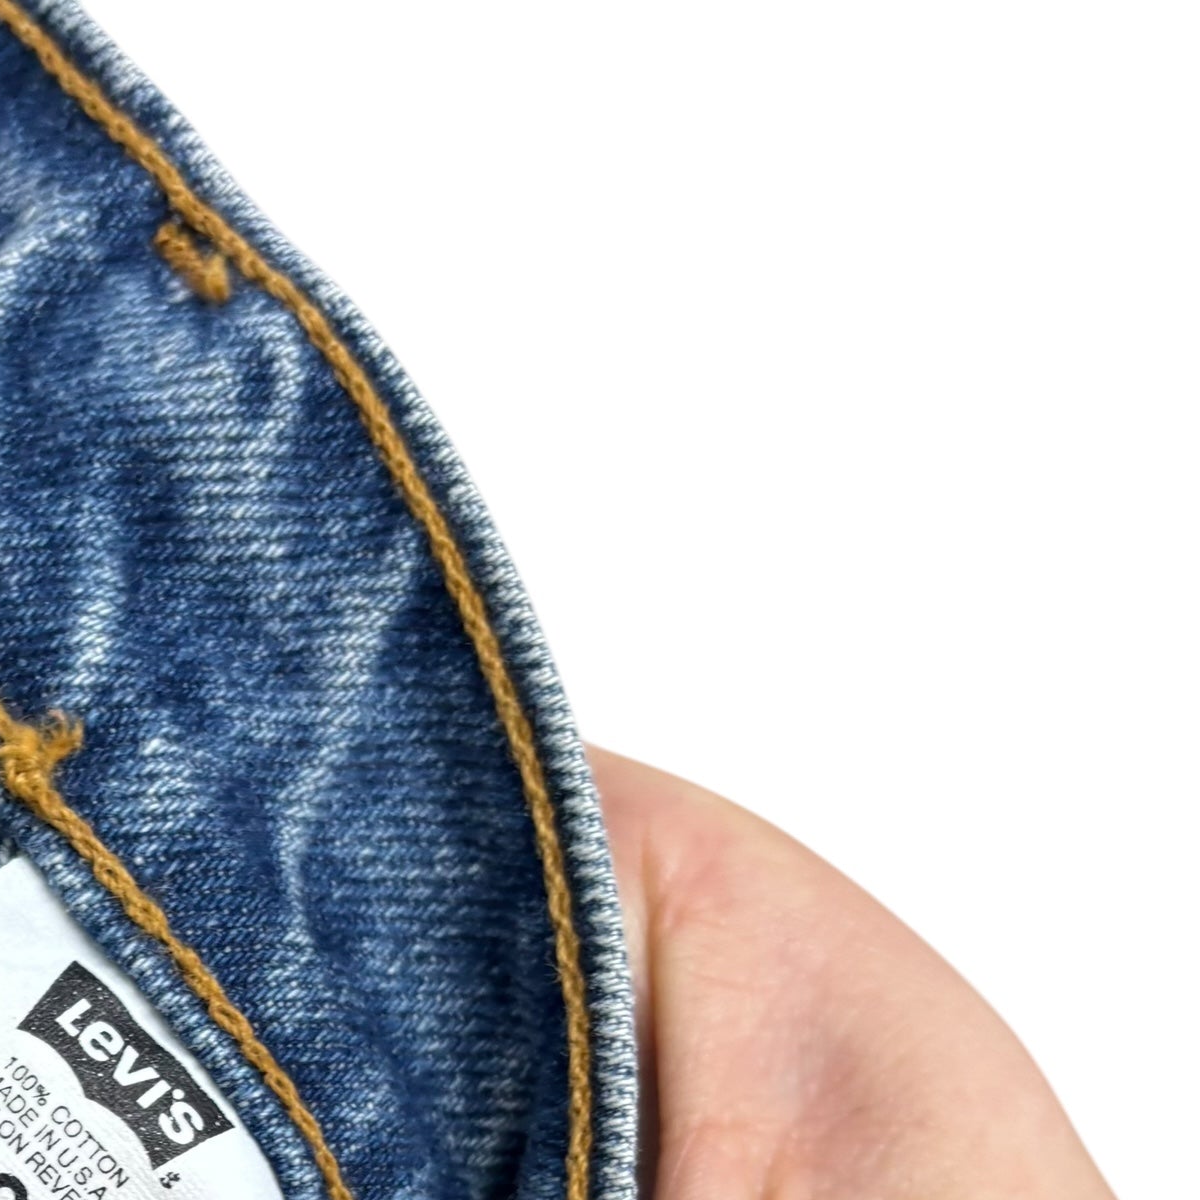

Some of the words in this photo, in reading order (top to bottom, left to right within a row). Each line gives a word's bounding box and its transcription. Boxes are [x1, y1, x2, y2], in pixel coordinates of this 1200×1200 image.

[4, 1057, 51, 1106] 100%
[51, 1105, 130, 1188] COTTON
[34, 1124, 60, 1150] IN
